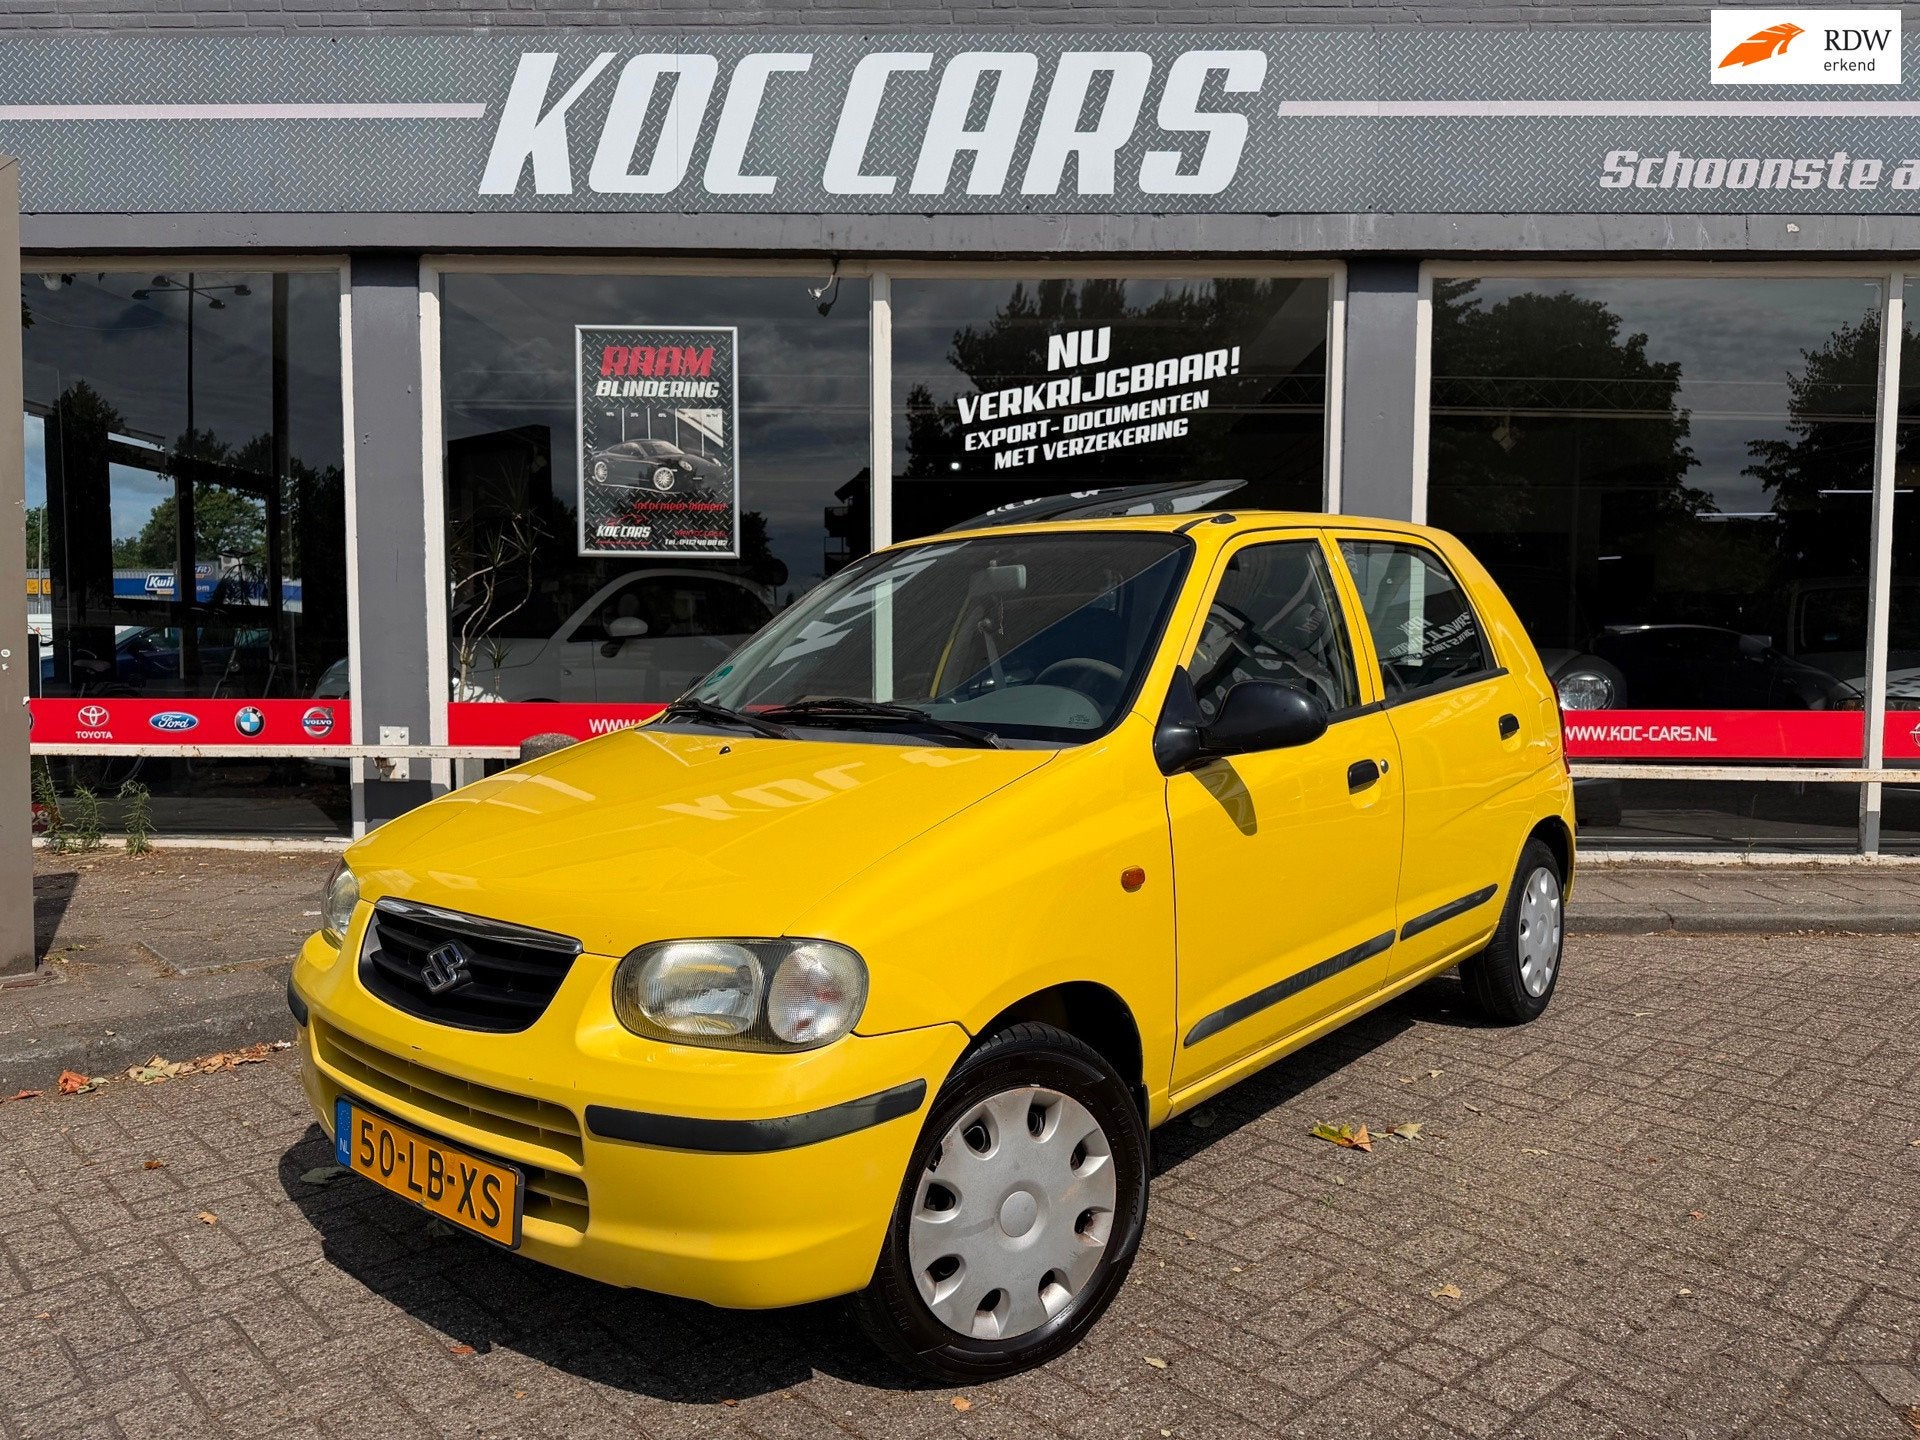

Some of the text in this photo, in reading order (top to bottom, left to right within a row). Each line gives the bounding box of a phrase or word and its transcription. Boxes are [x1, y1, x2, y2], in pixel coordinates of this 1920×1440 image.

[478, 50, 1268, 195] KOC CARS
[1600, 150, 1882, 190] Schoonste
[601, 346, 716, 377] RAAM
[1047, 326, 1111, 371] NU
[595, 381, 720, 398] BLINDERING
[957, 346, 1241, 425] VERKRIJGBAAR!
[994, 418, 1190, 471] MET VERZEKERING
[596, 525, 652, 538] KOC CARS
[76, 730, 113, 740] TOYOTA
[158, 714, 190, 728] Ford
[339, 1137, 350, 1155] NL
[360, 1119, 502, 1229] 50-LB-XS
